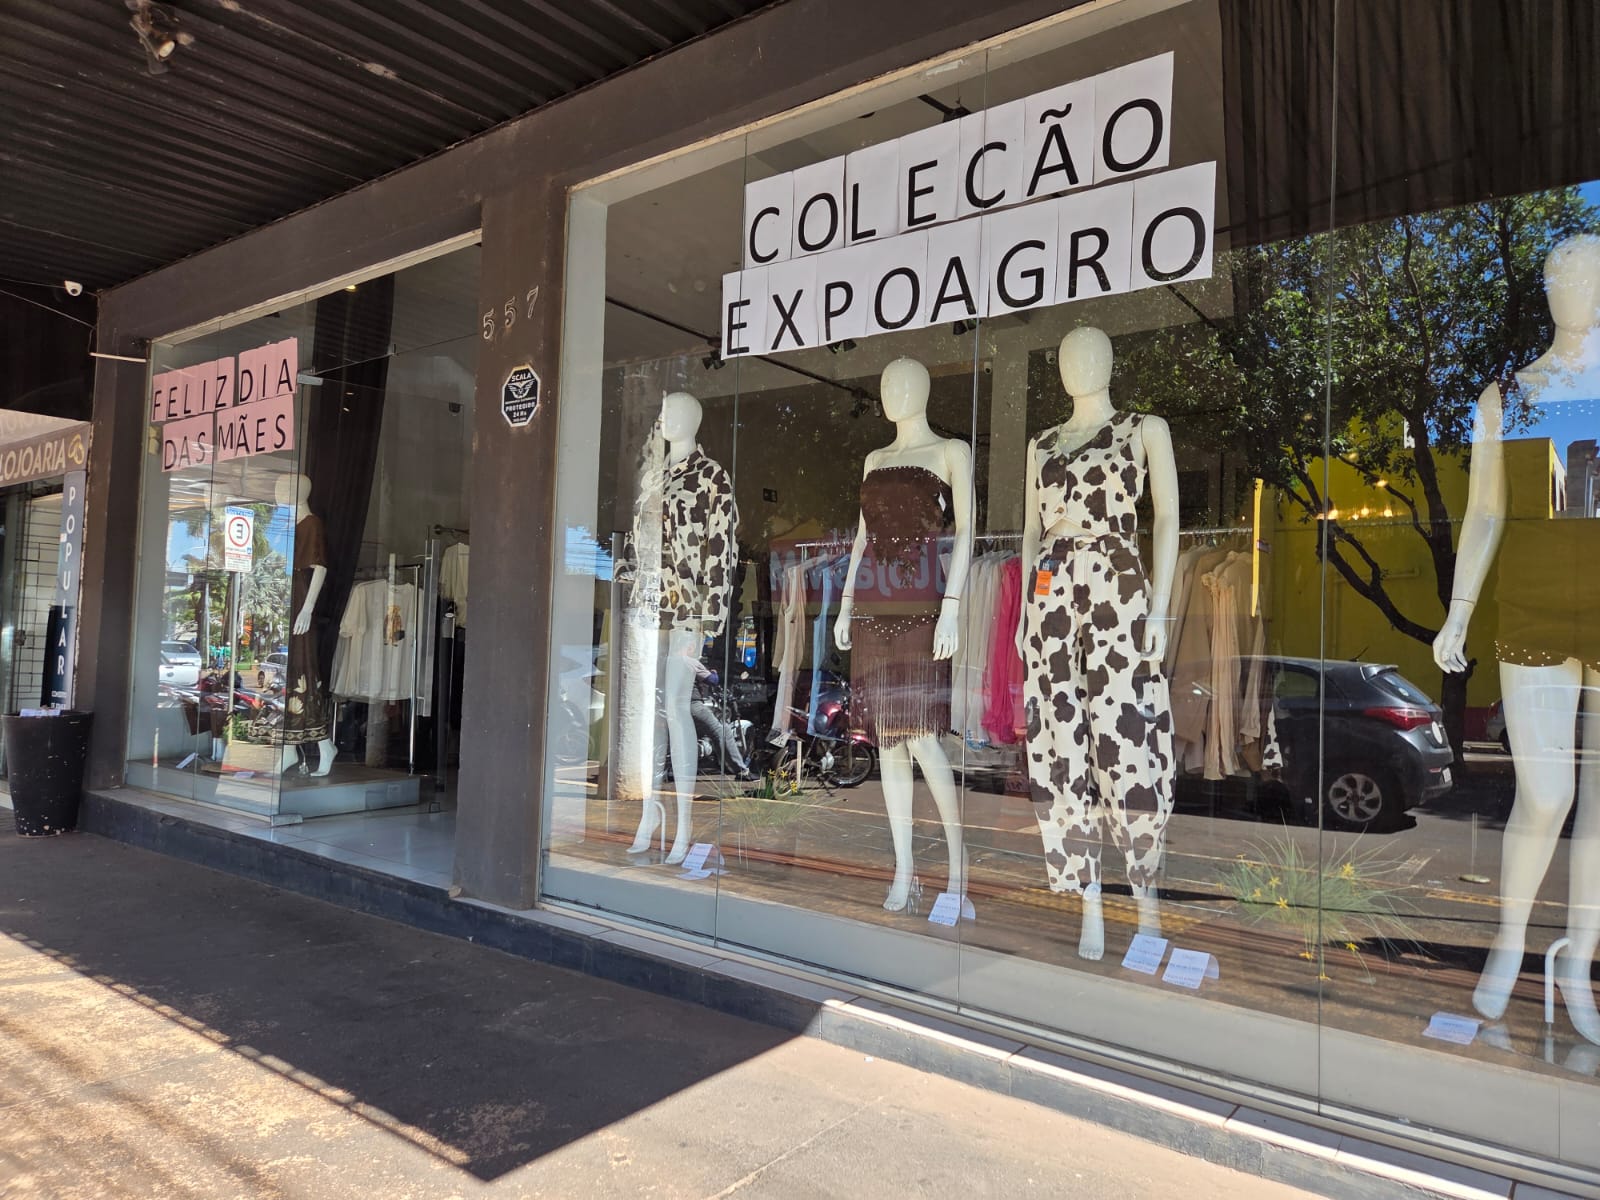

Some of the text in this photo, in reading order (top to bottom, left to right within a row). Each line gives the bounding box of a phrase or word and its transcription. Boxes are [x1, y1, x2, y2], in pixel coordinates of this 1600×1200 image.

[749, 98, 1164, 264] COLECÃO
[483, 285, 539, 340] 557
[726, 206, 1207, 356] EXPOAGRO
[152, 358, 293, 421] FELIZ DIA
[511, 373, 532, 382] SCALA
[164, 413, 287, 470] DAS MÃES
[57, 486, 76, 675] POPULAR
